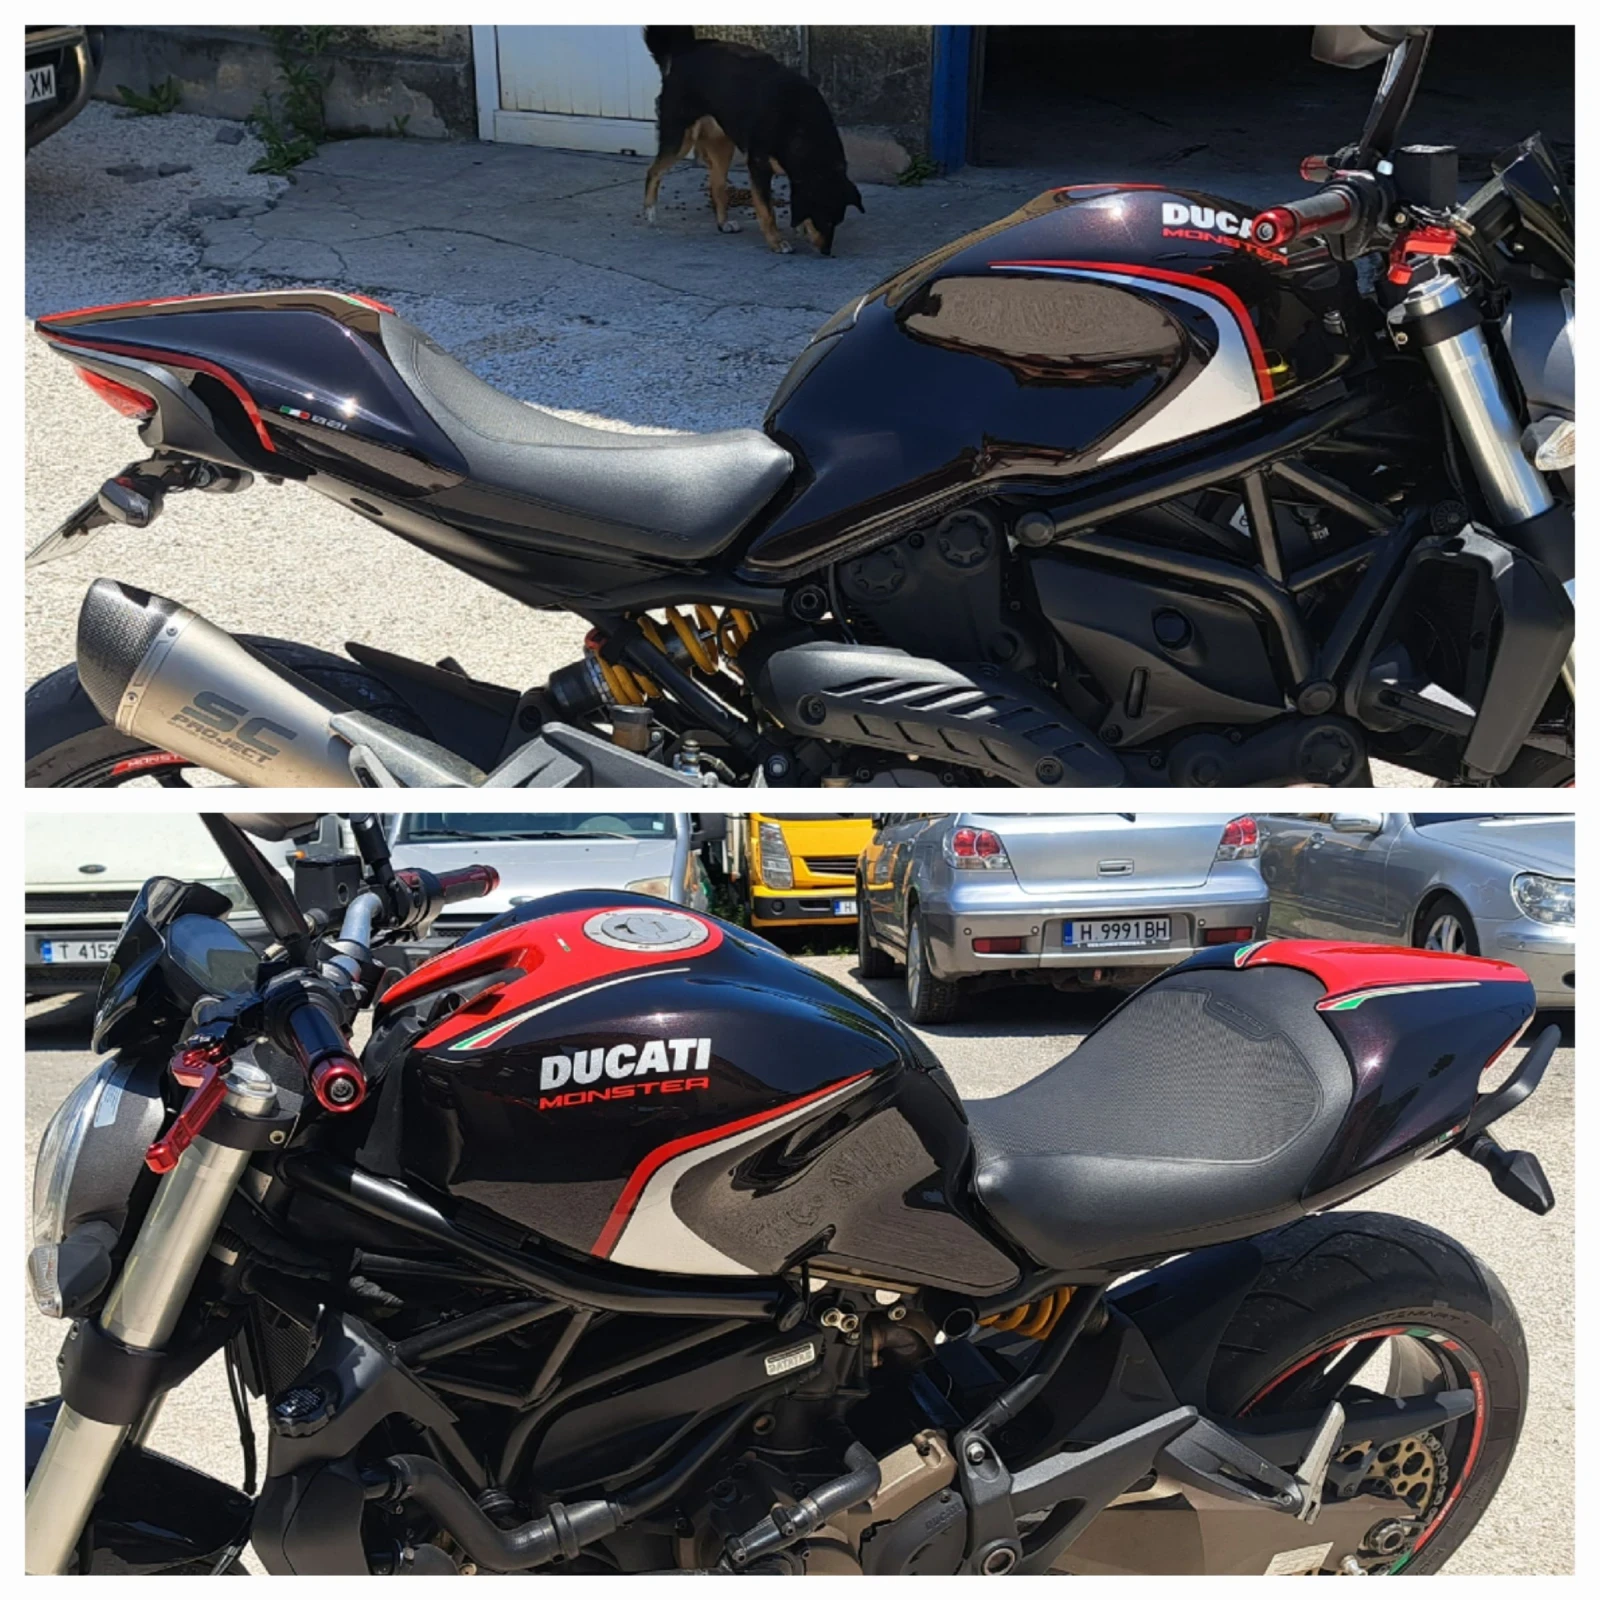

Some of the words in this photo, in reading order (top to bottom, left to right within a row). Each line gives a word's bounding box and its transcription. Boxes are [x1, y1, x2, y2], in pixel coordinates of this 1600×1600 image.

[1162, 202, 1254, 240] DUCA
[171, 713, 273, 764] PROJECT
[180, 690, 298, 756] SC
[1080, 924, 1092, 941] H
[1101, 921, 1141, 940] 9991
[1145, 920, 1167, 939] BH
[58, 943, 69, 960] T
[539, 1037, 713, 1091] DUCATI
[539, 1076, 710, 1111] MONSTER
